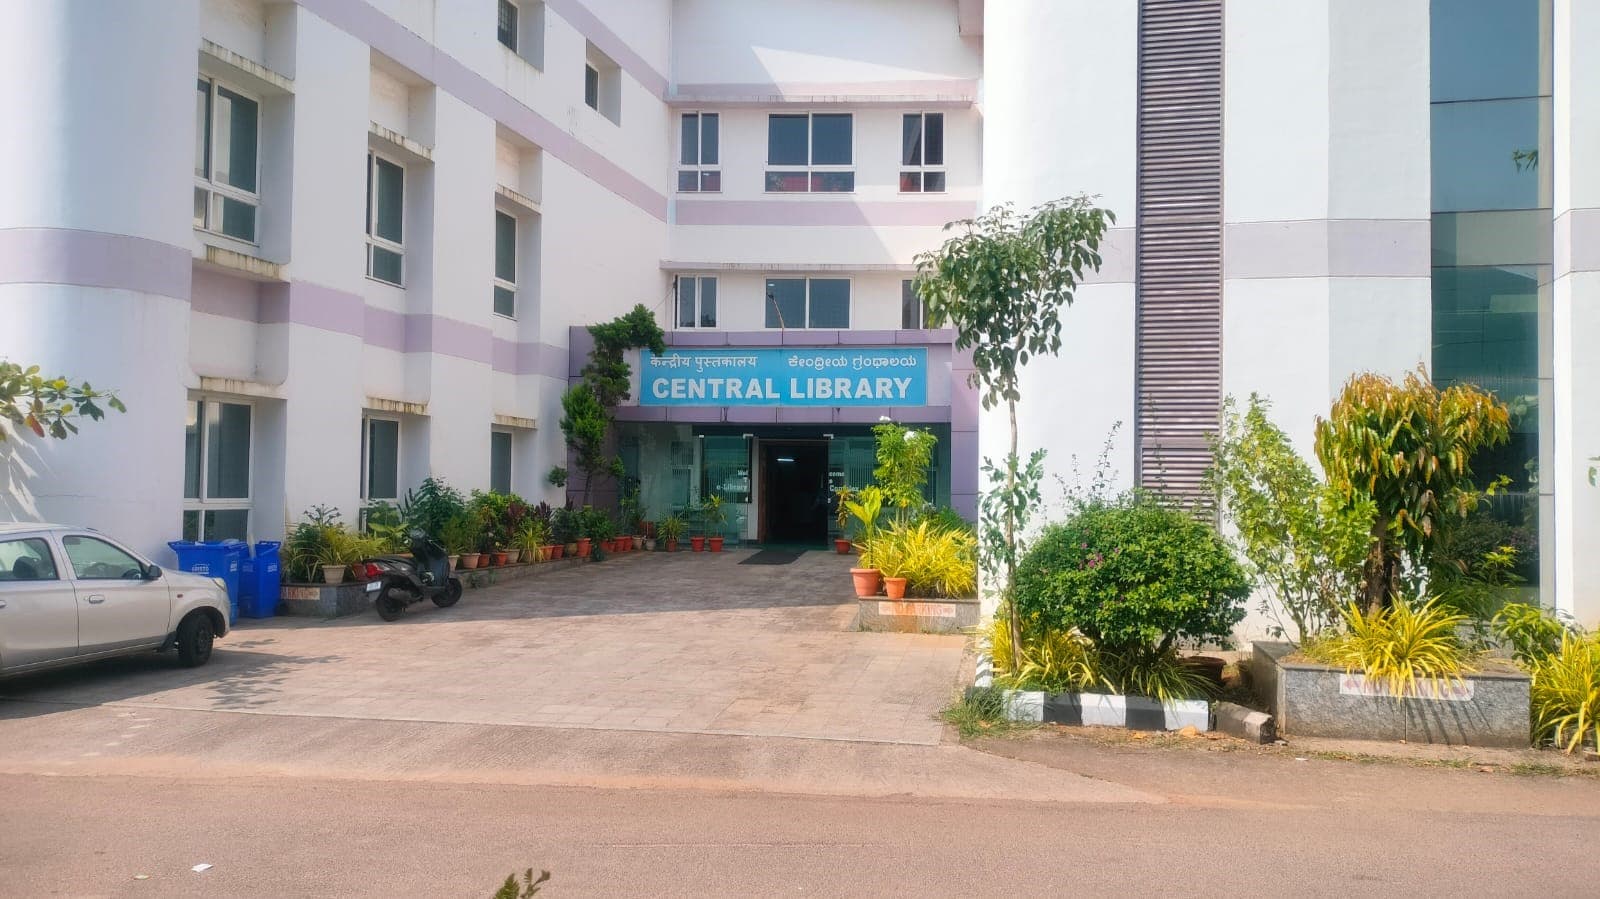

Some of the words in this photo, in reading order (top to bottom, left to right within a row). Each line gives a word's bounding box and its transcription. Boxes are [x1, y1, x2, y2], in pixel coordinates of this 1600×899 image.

[650, 354, 692, 369] केन्द्रीय
[695, 356, 758, 373] पुस्तकालय
[788, 355, 848, 371] ಕೇಂದ್ರೀಯ
[652, 378, 780, 399] CENTRAL
[790, 378, 913, 399] LIBRARY
[829, 484, 860, 492] Comlex
